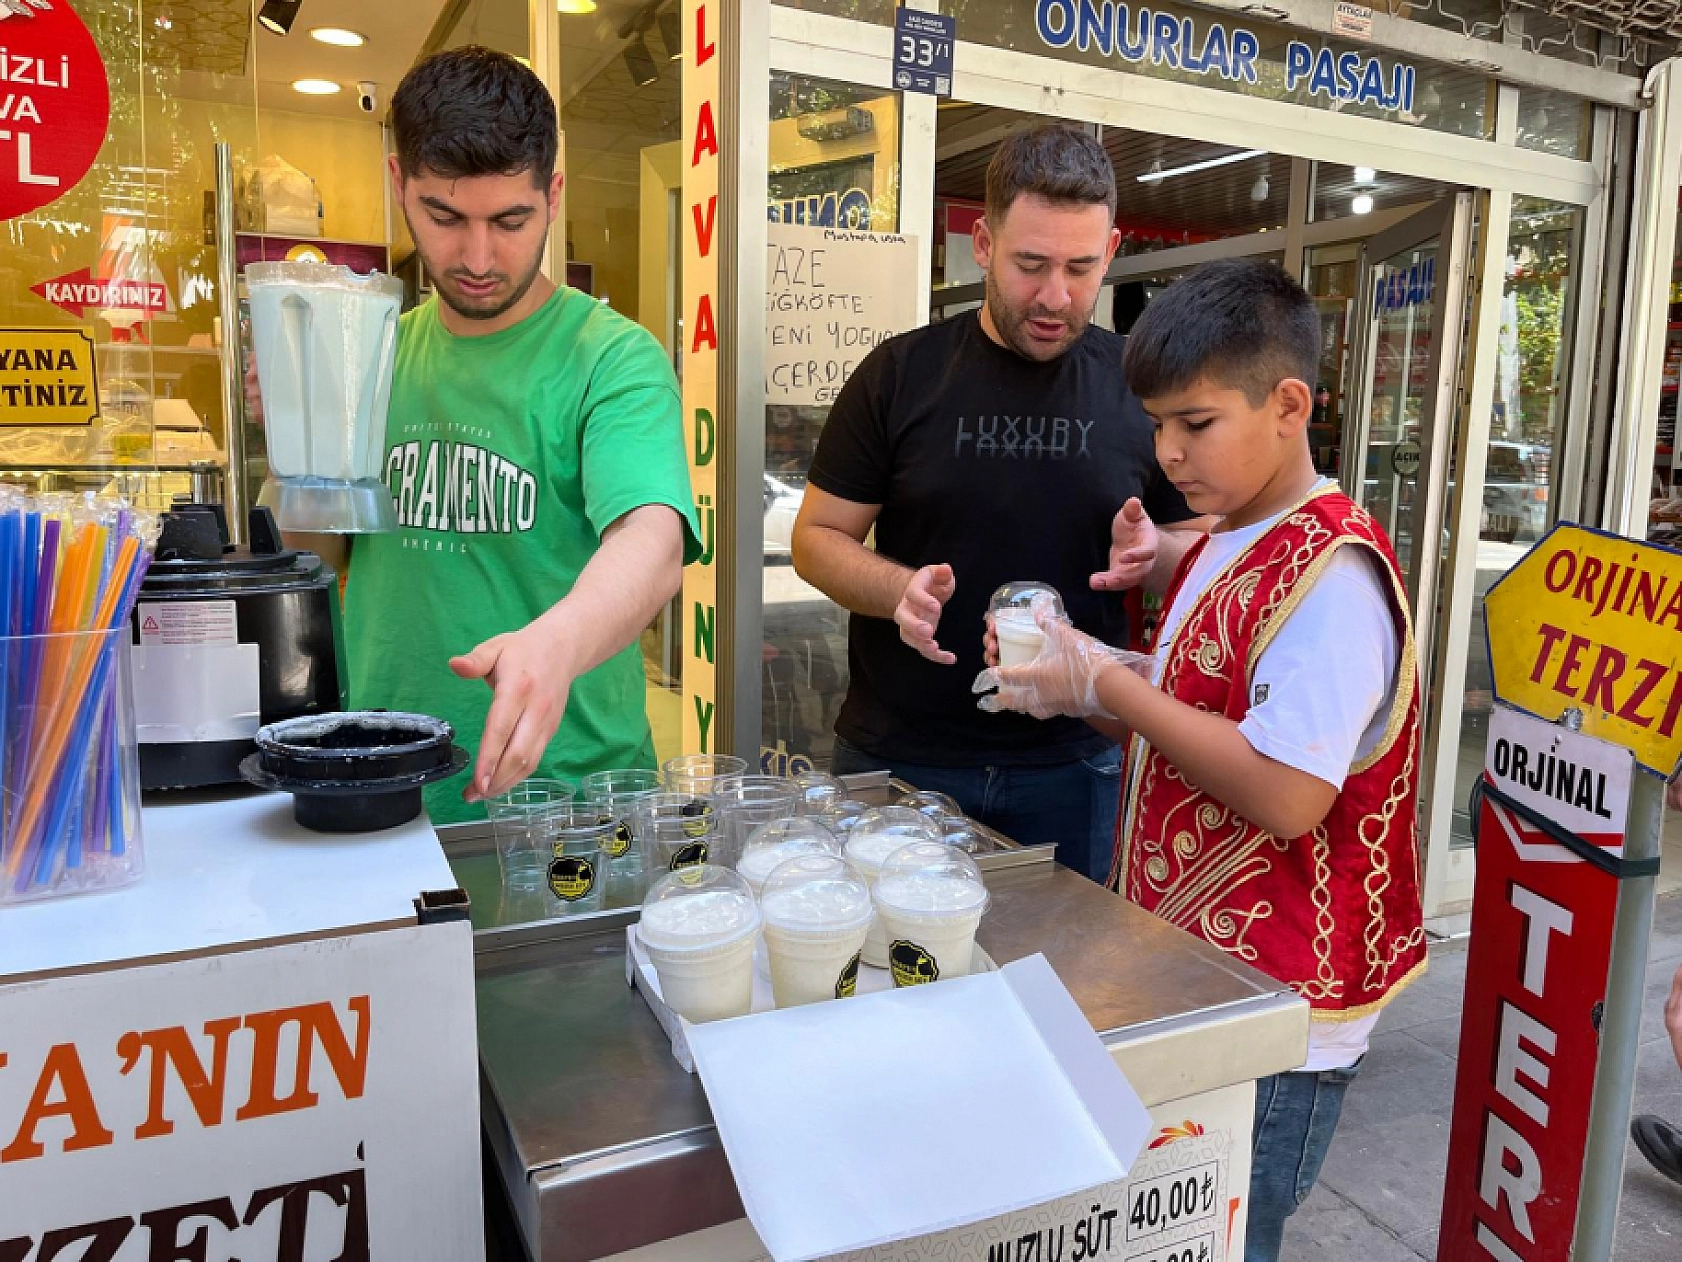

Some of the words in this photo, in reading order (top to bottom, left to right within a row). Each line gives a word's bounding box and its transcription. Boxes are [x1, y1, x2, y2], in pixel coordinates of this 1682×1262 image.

[0, 47, 69, 89] İZLİ
[1035, 0, 1259, 84] ONURLAR
[1285, 41, 1416, 112] PASAJI
[692, 4, 718, 353] LAVA
[45, 282, 164, 307] KAYDIRINIZ
[766, 288, 864, 314] İĞKÖFTE
[765, 323, 812, 347] ENİ
[1494, 737, 1612, 820] ORJİNAL
[0, 994, 371, 1164] A'NIN
[1476, 882, 1574, 1262] TER
[1072, 1202, 1118, 1262] SÜT
